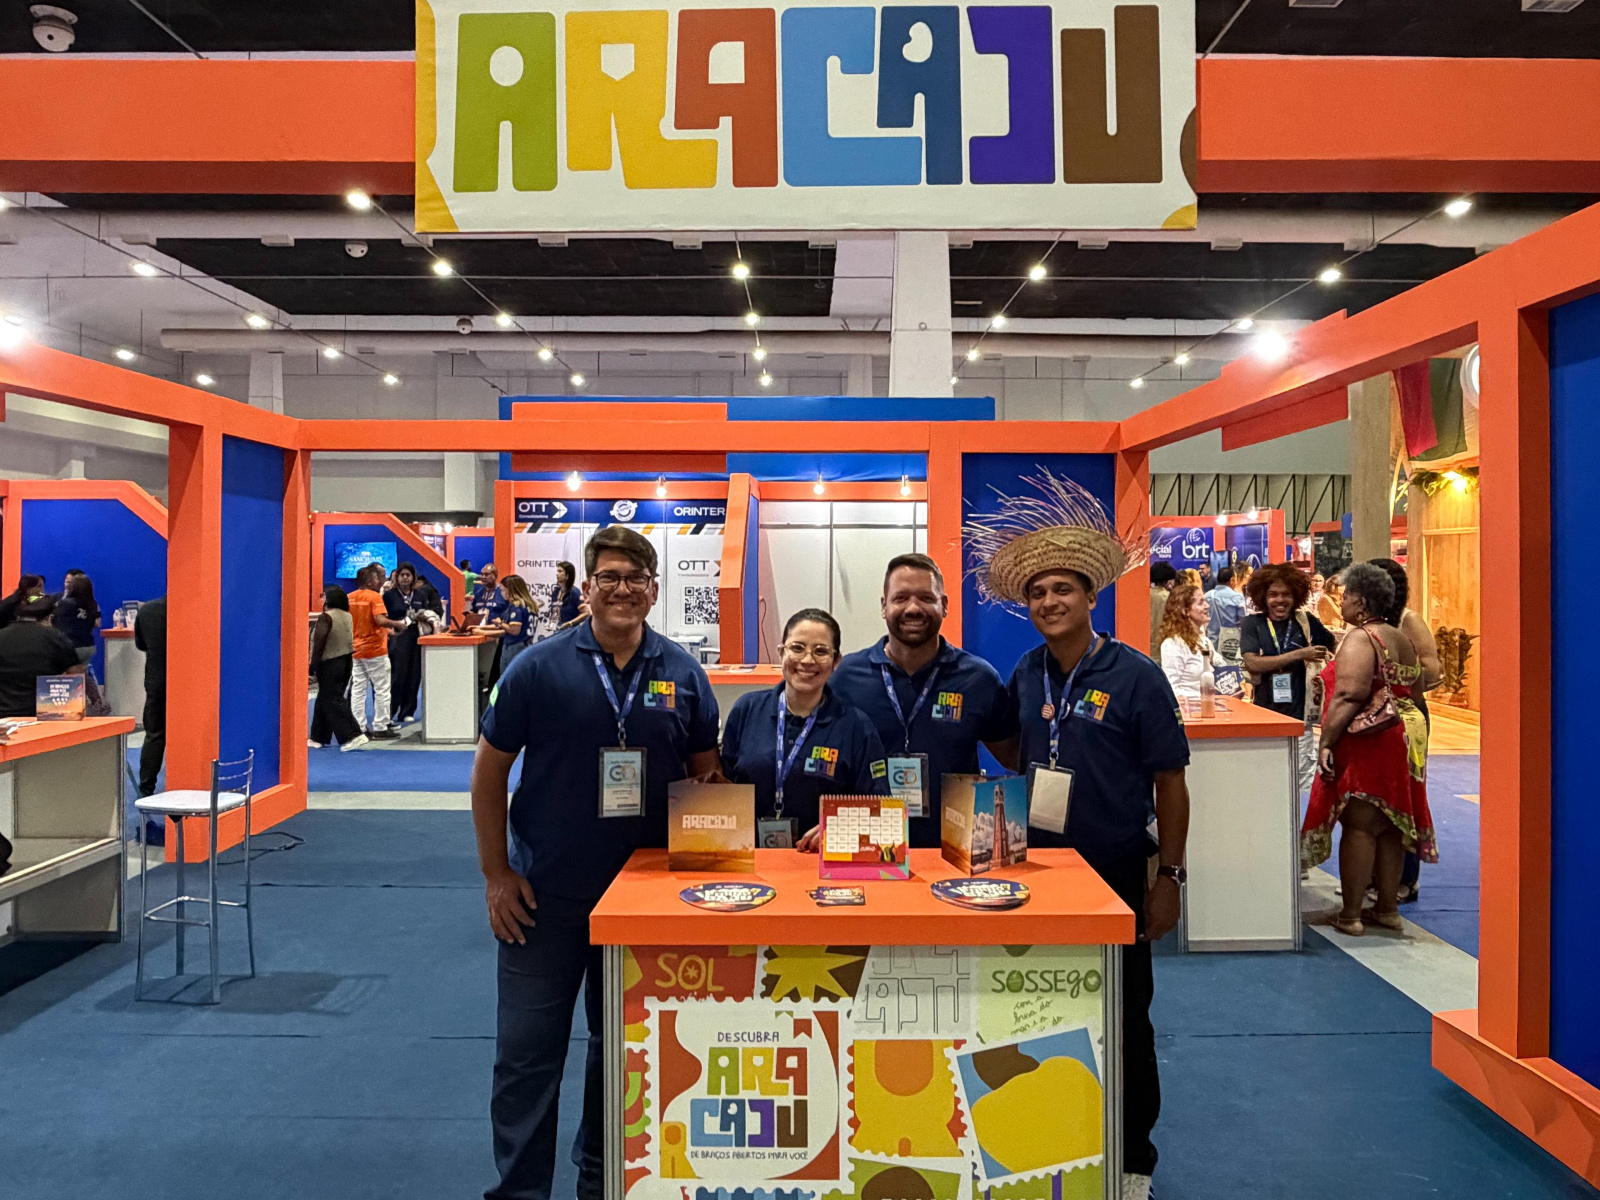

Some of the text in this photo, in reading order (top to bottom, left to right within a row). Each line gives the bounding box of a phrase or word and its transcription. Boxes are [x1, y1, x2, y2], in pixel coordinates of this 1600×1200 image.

[453, 5, 1163, 192] ARACAJU
[518, 501, 549, 513] OTT
[673, 506, 725, 516] ORINTER
[1182, 540, 1210, 559] brt
[677, 560, 709, 571] OTT
[649, 680, 676, 695] ARA
[938, 691, 963, 707] ARA
[811, 745, 839, 763] ARA
[682, 815, 737, 830] ARACAJU
[655, 952, 724, 992] SOL
[717, 1031, 780, 1043] DESCUBRA
[707, 1047, 808, 1096] ARA
[690, 1098, 808, 1148] CAJU
[690, 1150, 809, 1160] DE BRAÇOS ABERTOS PARA VOCÊ
